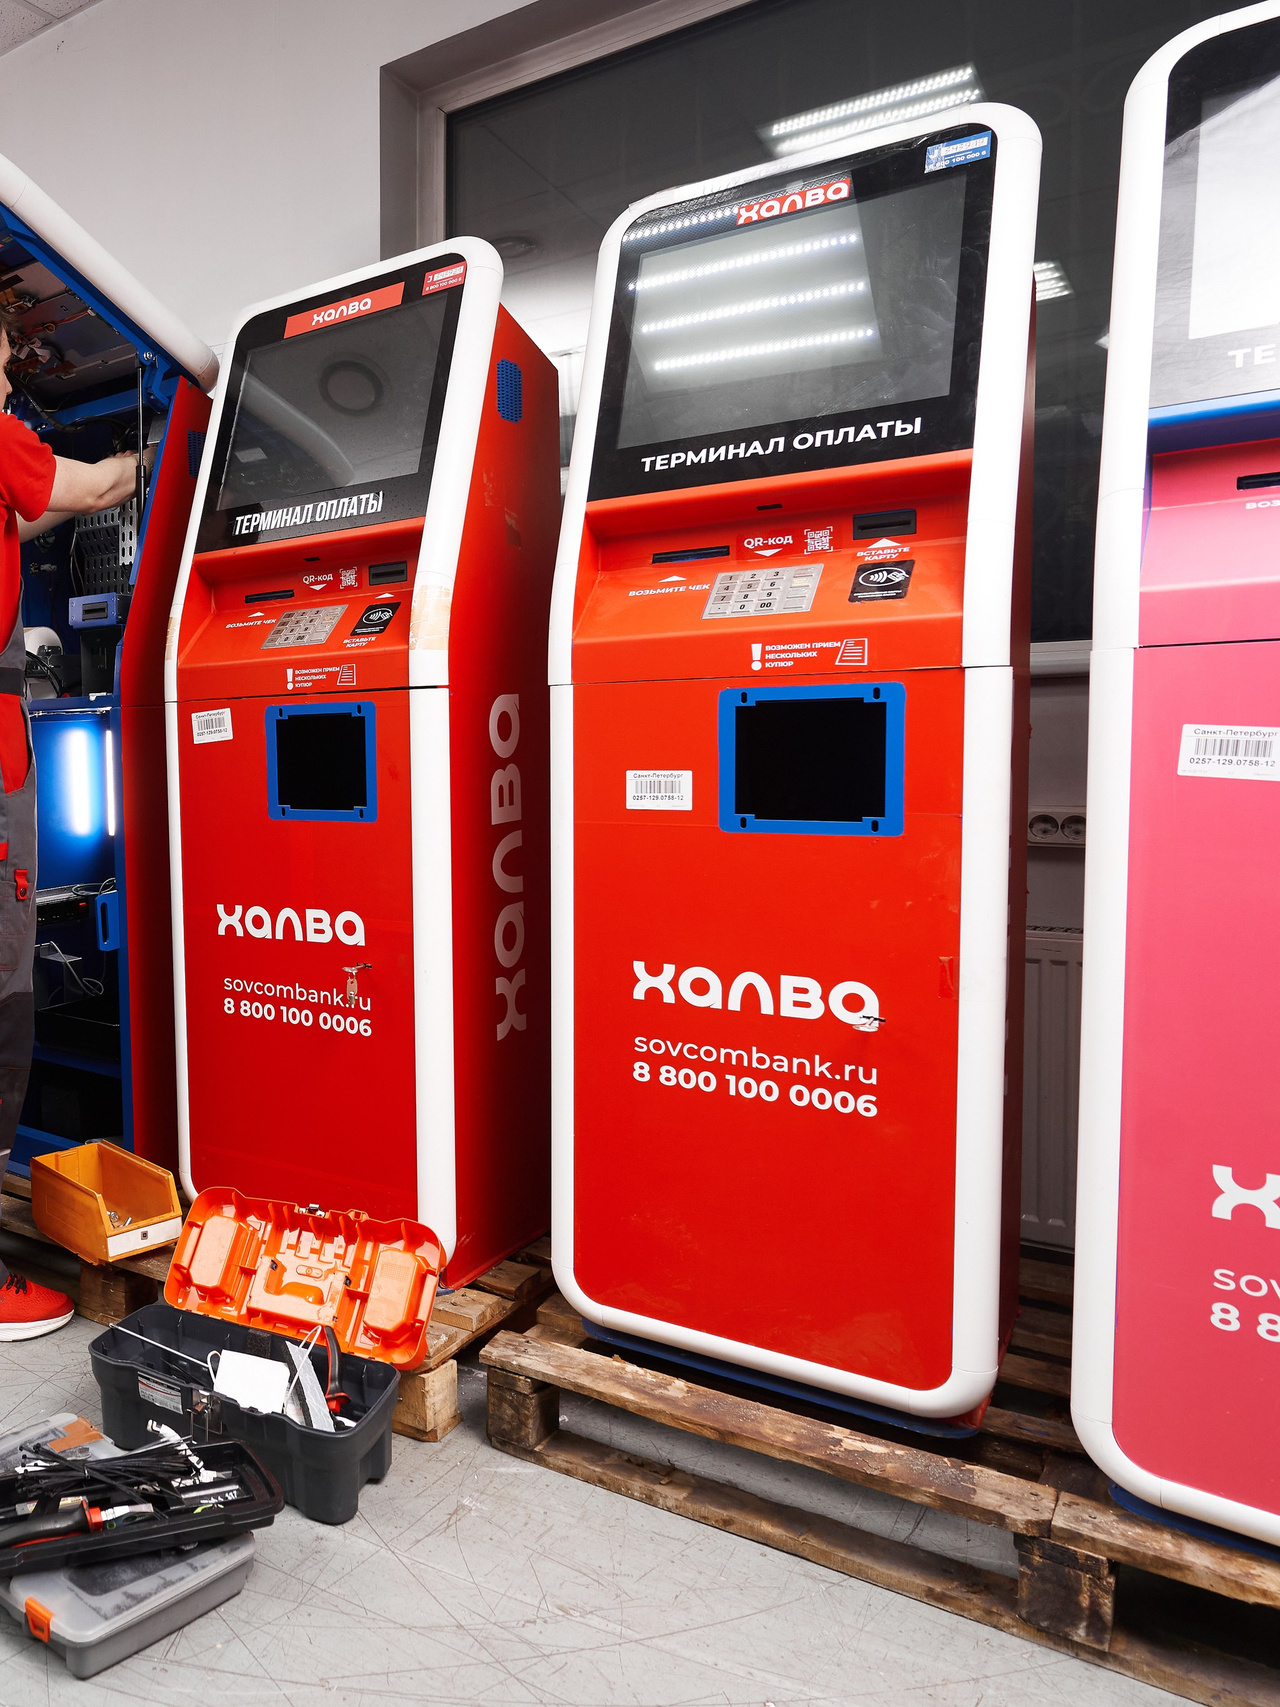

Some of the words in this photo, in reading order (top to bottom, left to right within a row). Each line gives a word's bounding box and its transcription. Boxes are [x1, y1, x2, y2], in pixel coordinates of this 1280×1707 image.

[641, 435, 785, 472] ТЕРМИНАЛ
[798, 417, 922, 450] ОПЛАТЫ
[233, 505, 312, 536] ТЕРМИНАЛ
[315, 491, 384, 523] ОПЛАТЫ
[744, 534, 793, 549] QR-код
[856, 547, 910, 557] ВСТАВЬТЕ
[864, 553, 899, 561] КАРТУ
[628, 586, 686, 596] ВОЗЬМИТЕ
[812, 641, 841, 649] ПРИЕМ
[765, 651, 818, 659] НЕСКОЛЬКИХ
[1193, 728, 1278, 738] Санкт-Петербург
[223, 997, 235, 1014] 8
[239, 999, 275, 1021] 800
[280, 1006, 313, 1027] 100
[319, 1012, 372, 1037] 0006
[634, 1036, 878, 1085] sovcombank.ru
[633, 1061, 651, 1082] 8
[659, 1065, 717, 1092] 800
[725, 1074, 779, 1102] 100
[789, 1085, 878, 1117] 0006
[1210, 1302, 1241, 1332] 8
